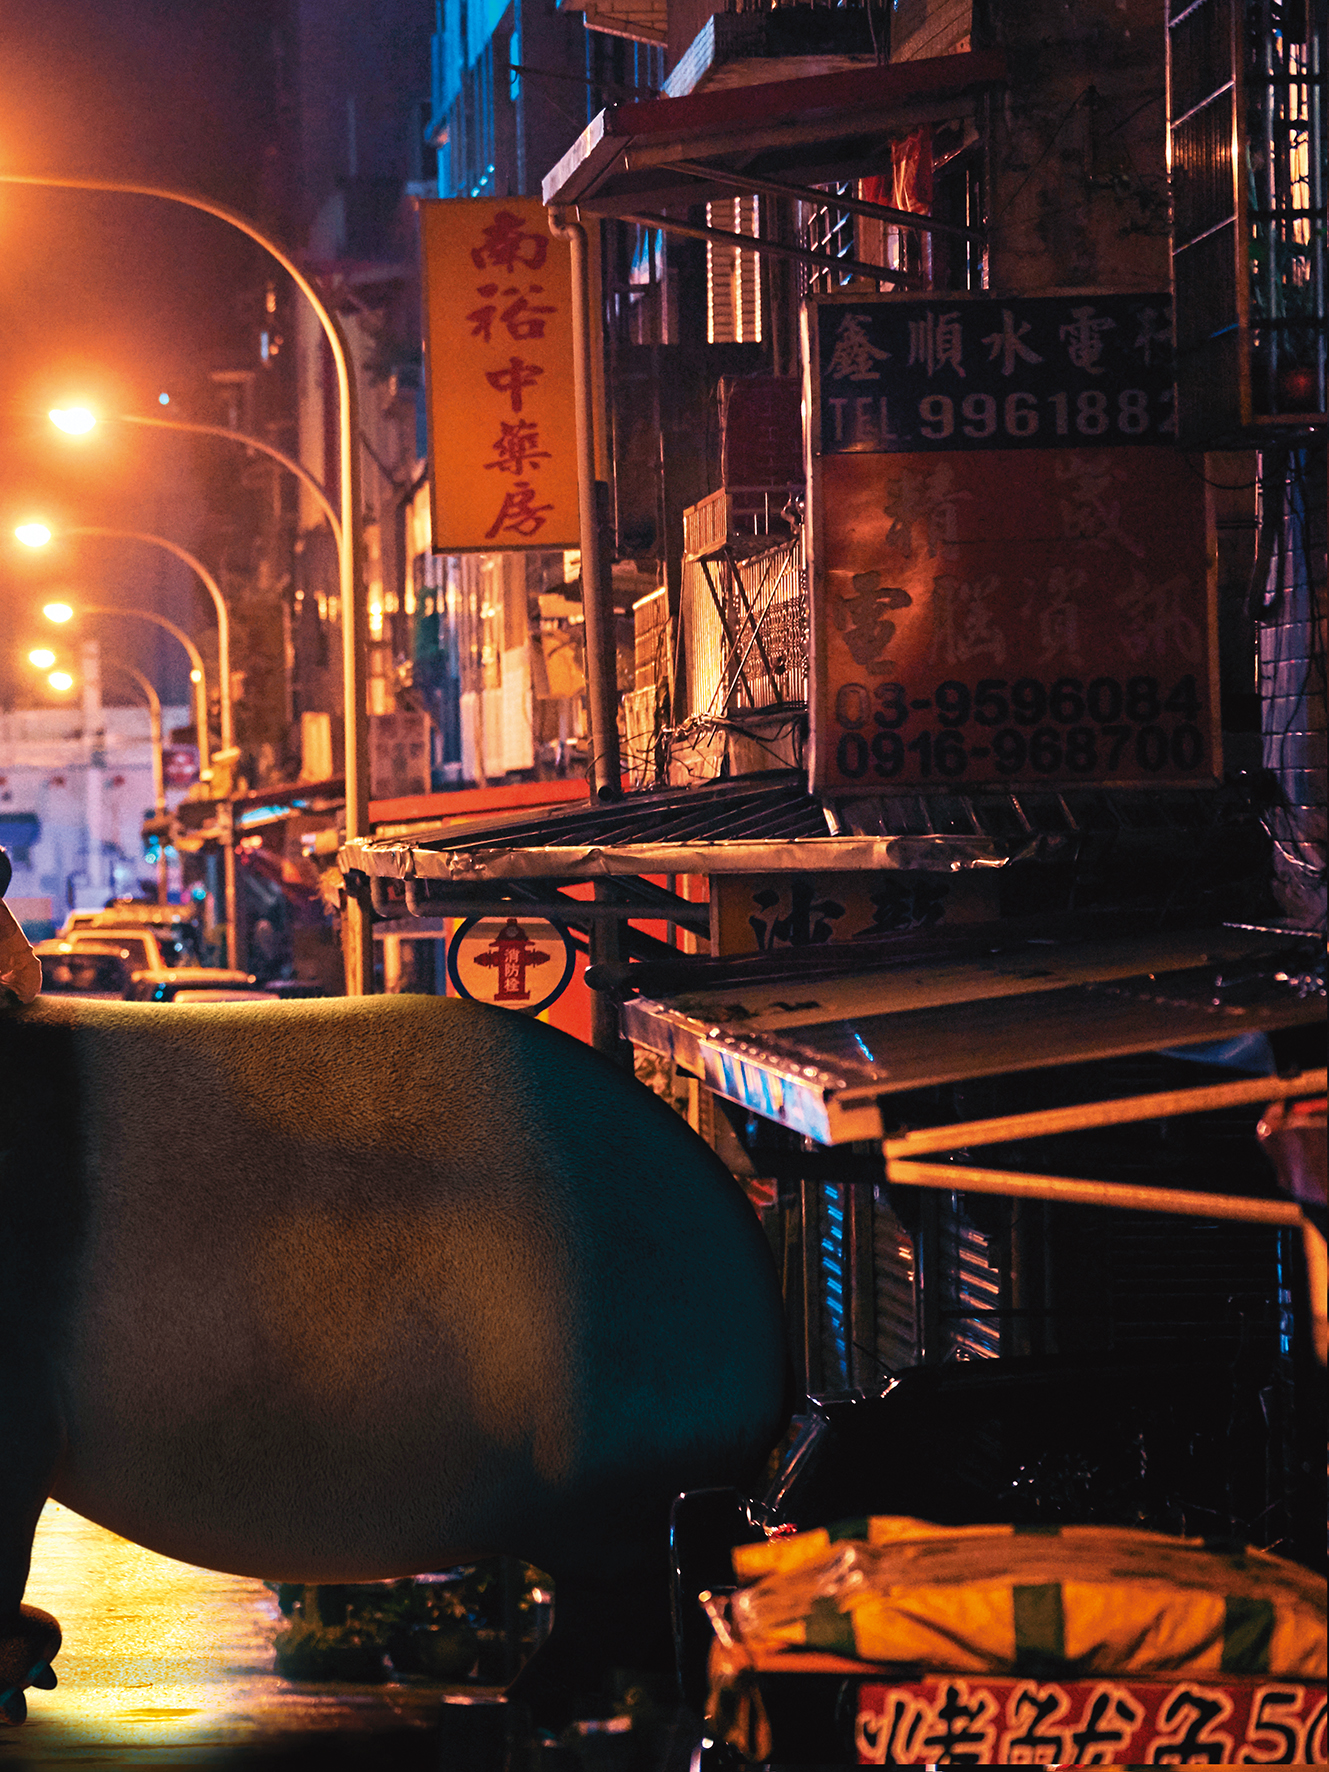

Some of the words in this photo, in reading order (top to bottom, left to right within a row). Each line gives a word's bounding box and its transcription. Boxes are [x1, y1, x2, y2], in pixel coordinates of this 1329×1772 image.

[466, 210, 558, 540] 南裕中藥房
[836, 674, 1204, 731] 03-9596084
[836, 724, 1205, 780] 0916-968700
[504, 948, 520, 992] 消防栓
